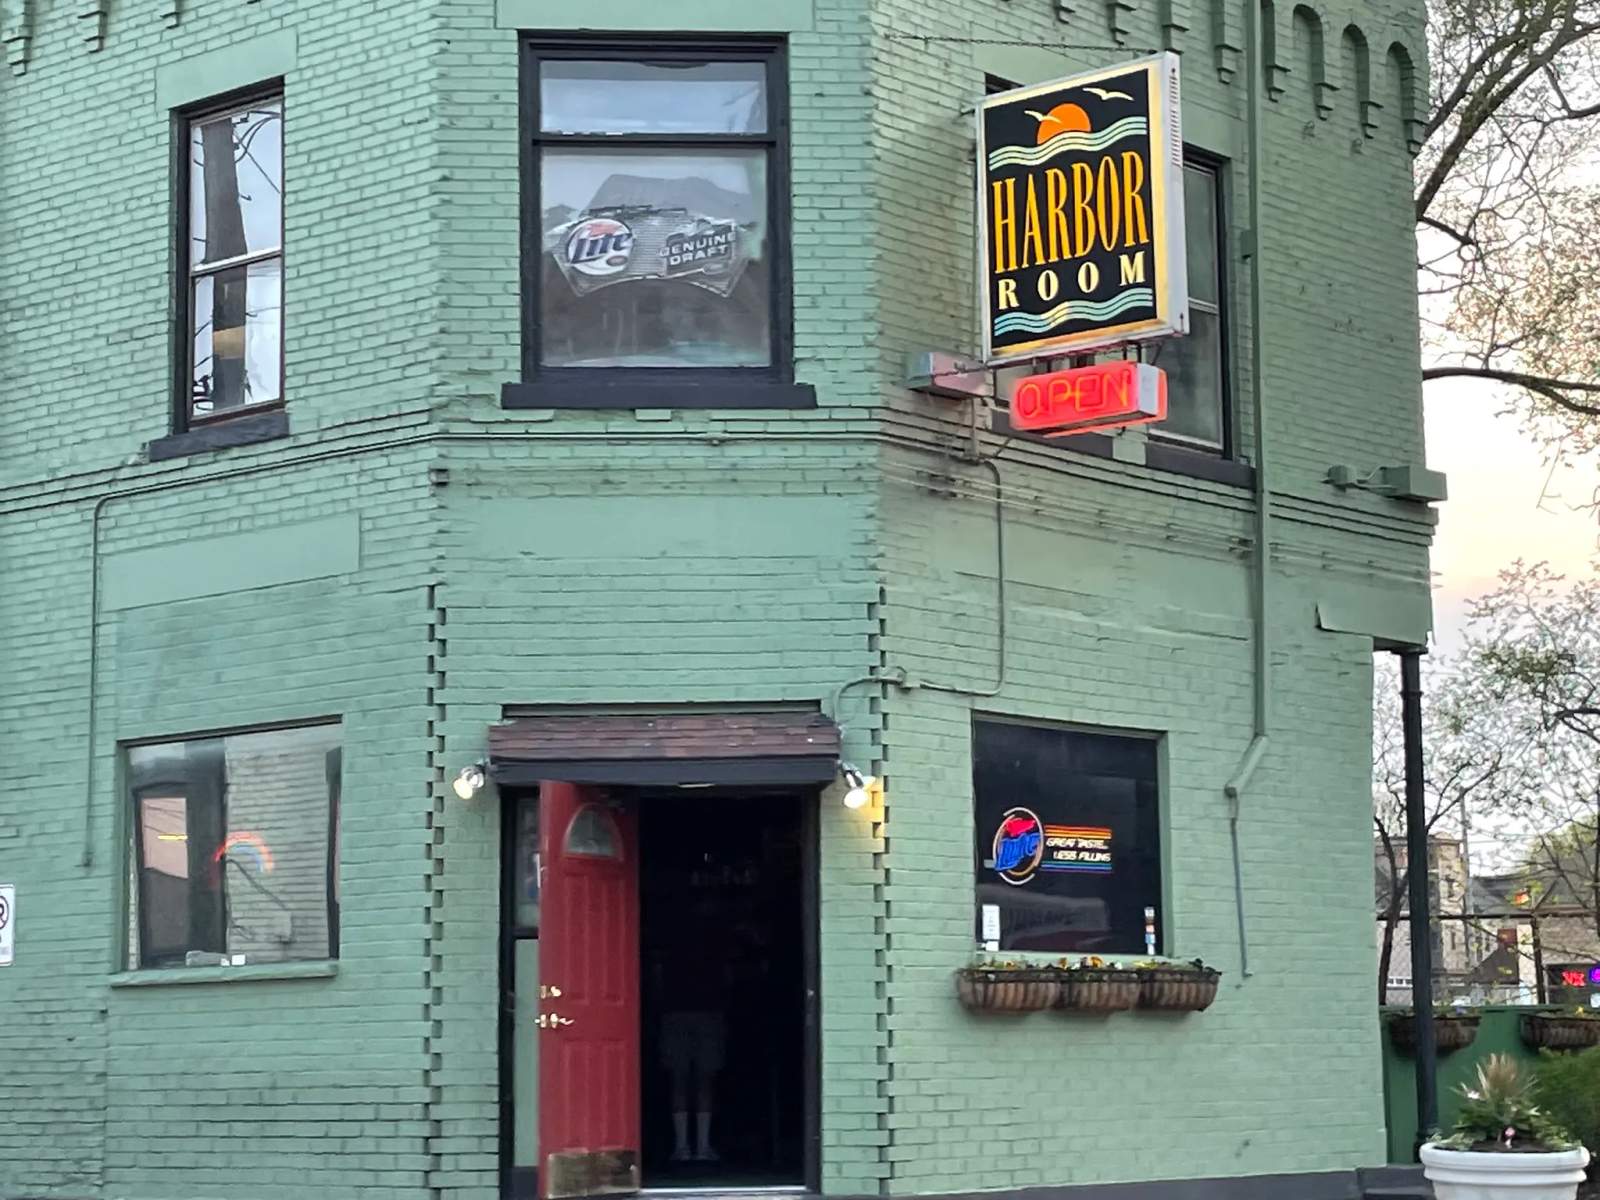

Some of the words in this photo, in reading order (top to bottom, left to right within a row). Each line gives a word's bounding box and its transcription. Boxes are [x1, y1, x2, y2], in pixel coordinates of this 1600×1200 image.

[993, 151, 1148, 273] HARBOR
[571, 233, 633, 262] Lite
[658, 231, 737, 257] GENUINE
[669, 244, 728, 266] DRAFT
[998, 252, 1146, 309] ROOM
[1018, 370, 1129, 419] OPEN
